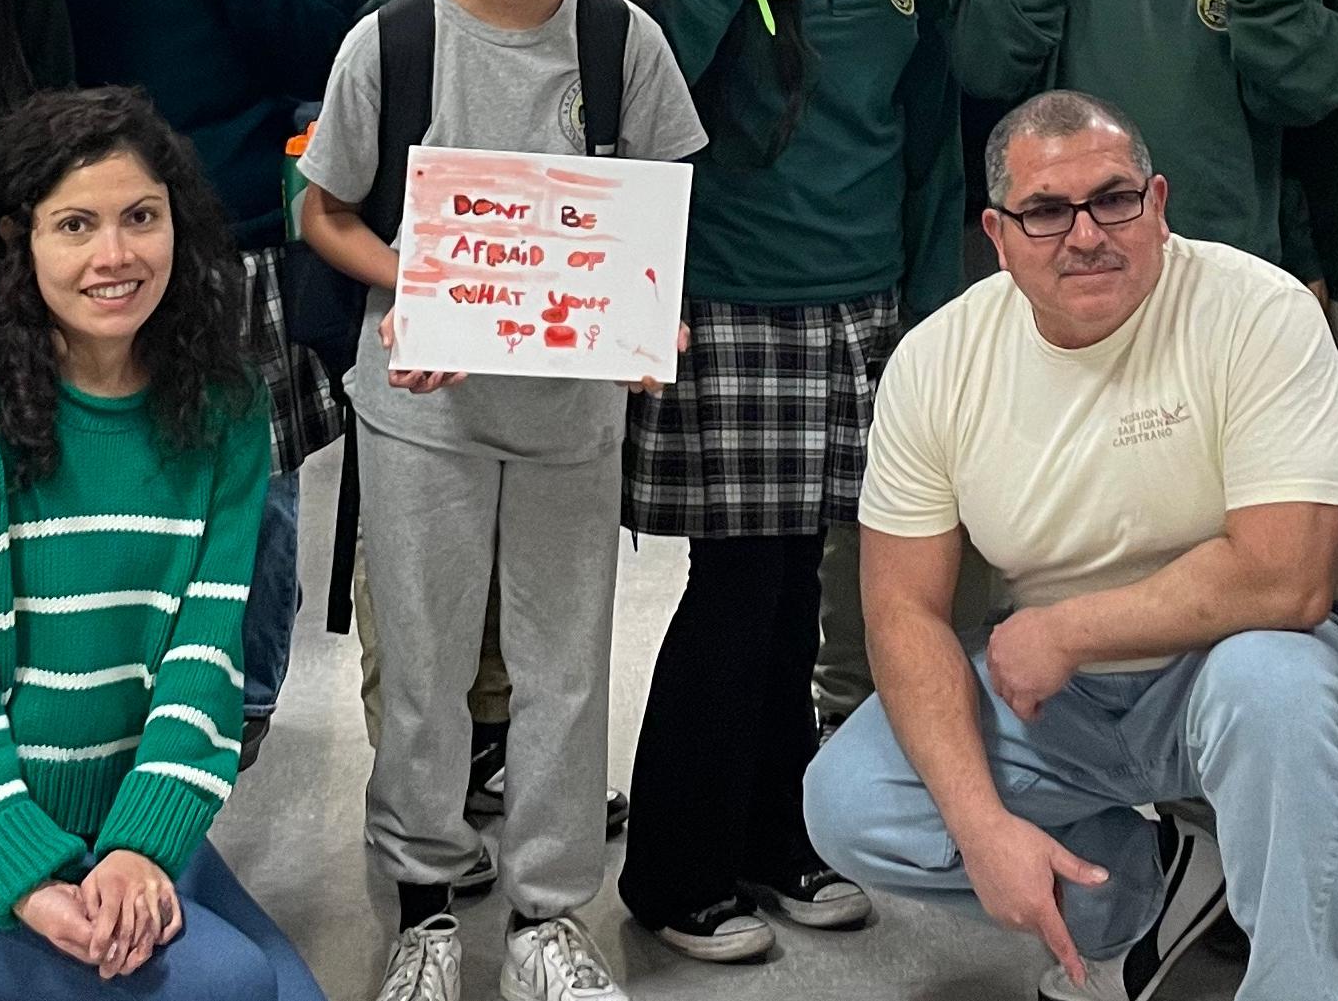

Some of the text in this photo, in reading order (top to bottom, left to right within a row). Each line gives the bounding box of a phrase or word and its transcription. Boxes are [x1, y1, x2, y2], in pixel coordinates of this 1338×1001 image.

[453, 194, 597, 229] DONT BE
[567, 251, 606, 271] OF
[448, 283, 526, 306] WHAT
[1119, 408, 1159, 425] MISSION
[1112, 427, 1173, 448] CAPISTRANO
[1117, 420, 1164, 436] SAN JUAN
